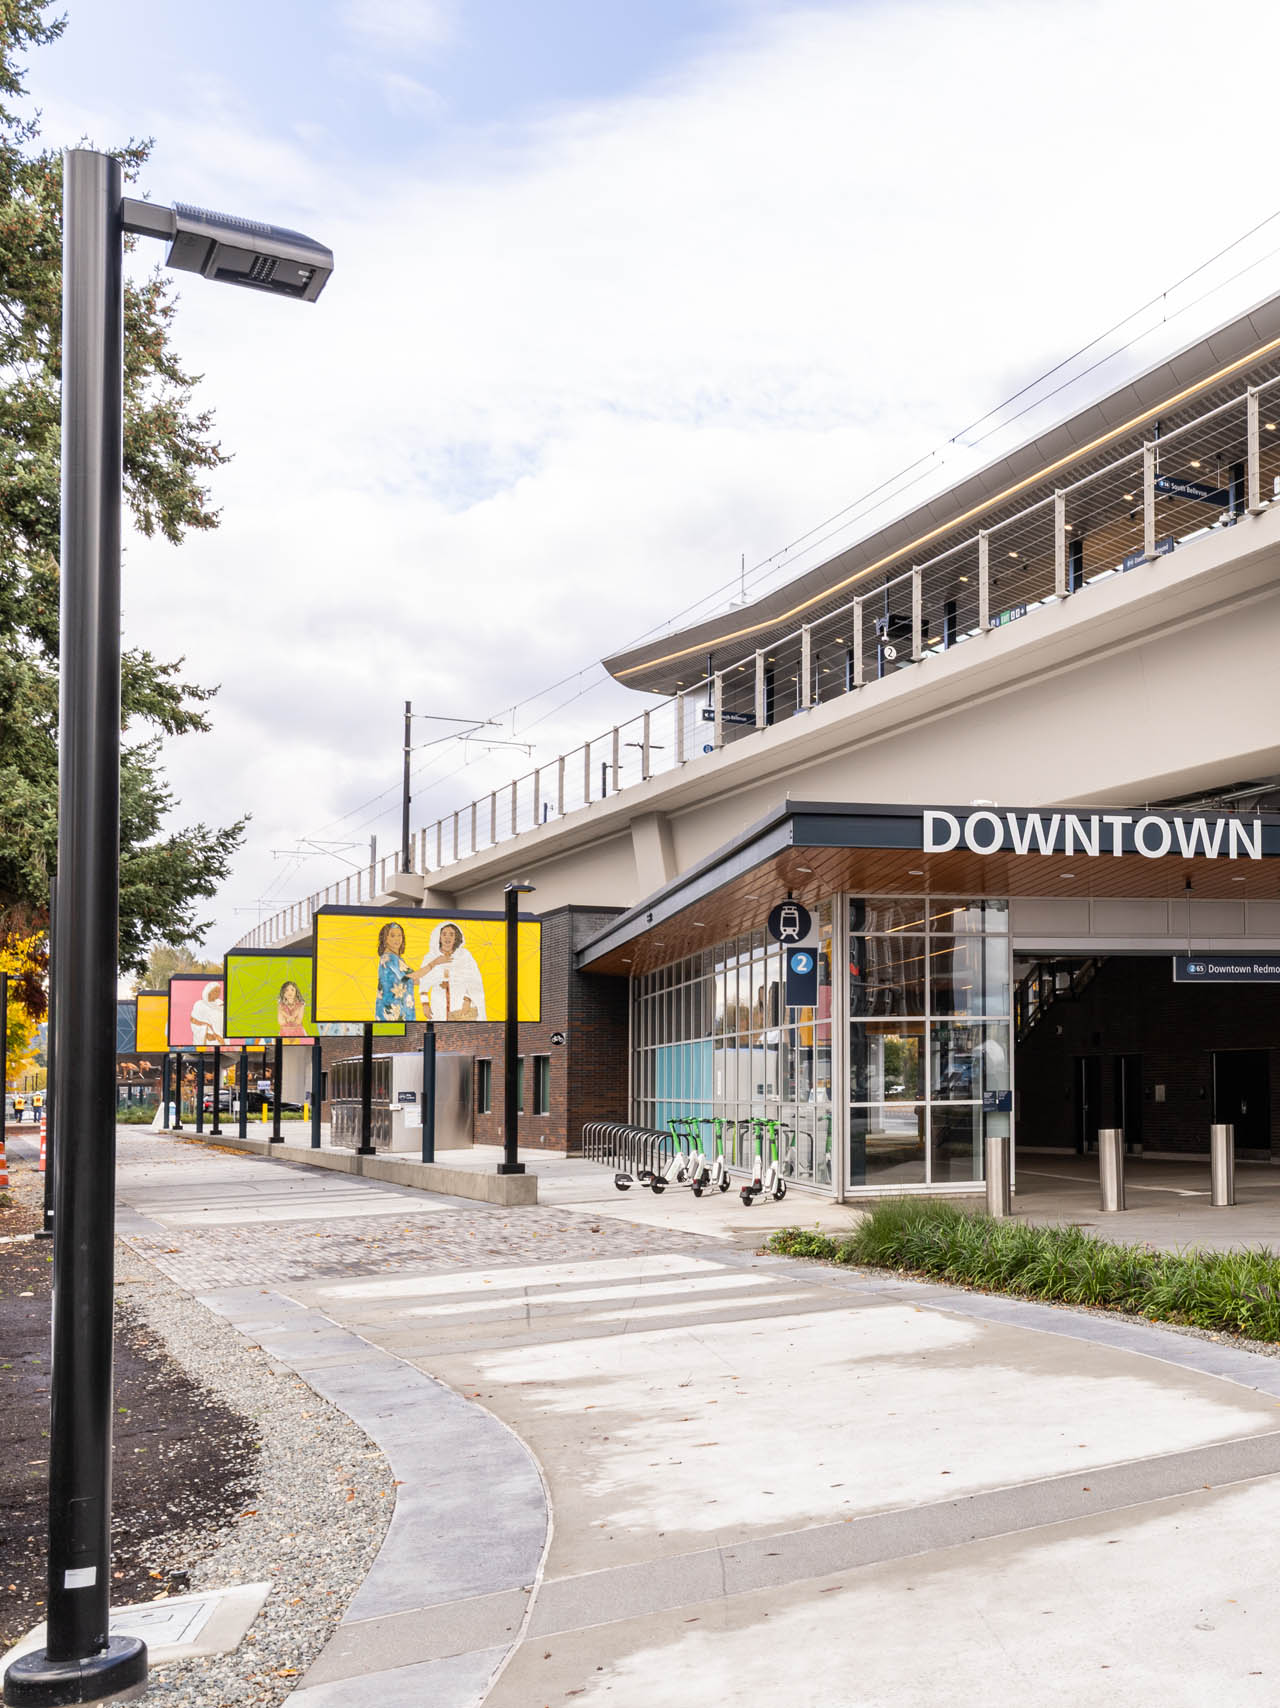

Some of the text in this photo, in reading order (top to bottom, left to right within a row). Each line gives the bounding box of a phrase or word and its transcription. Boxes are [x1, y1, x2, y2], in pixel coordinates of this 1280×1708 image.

[922, 810, 1262, 860] DOWNTOWN
[796, 955, 808, 971] 2
[1208, 964, 1252, 974] Downtown
